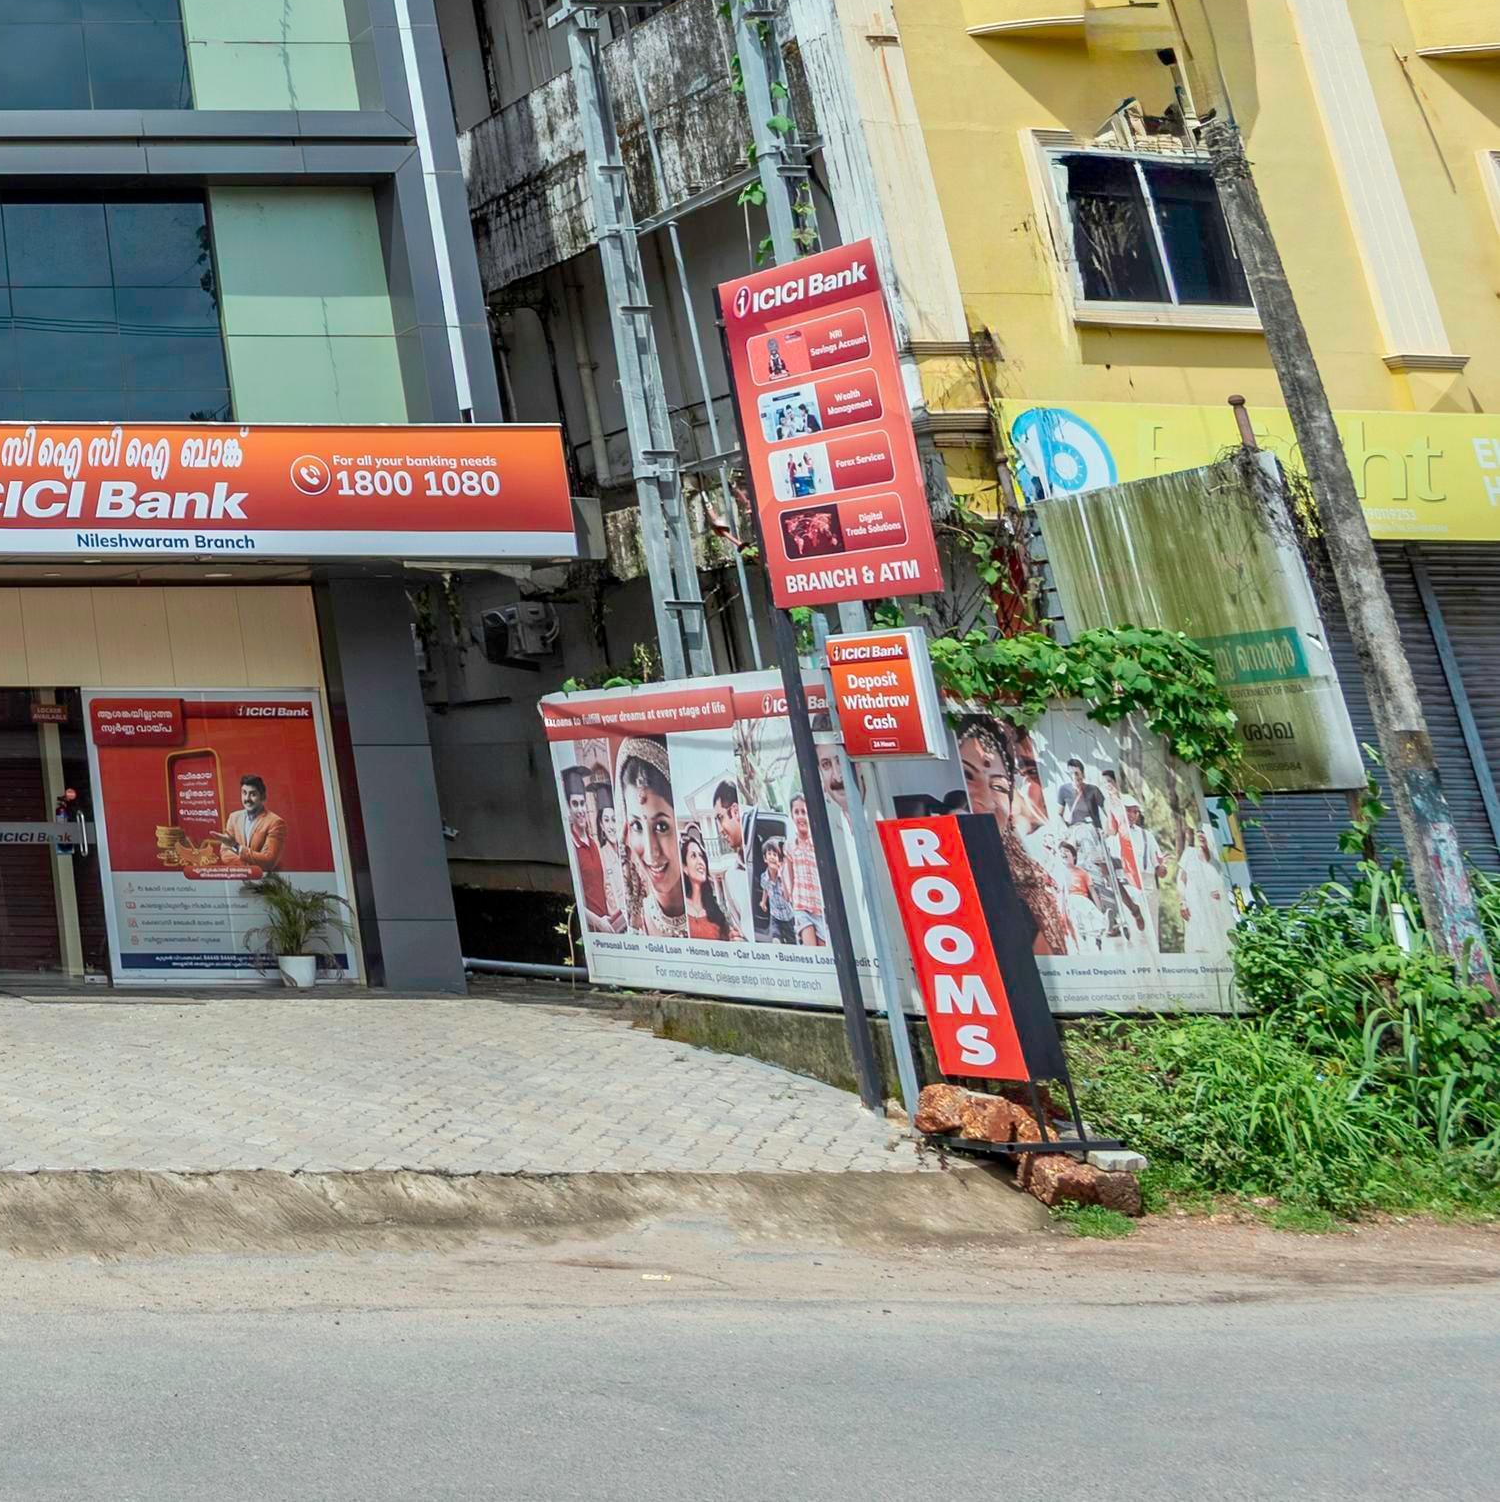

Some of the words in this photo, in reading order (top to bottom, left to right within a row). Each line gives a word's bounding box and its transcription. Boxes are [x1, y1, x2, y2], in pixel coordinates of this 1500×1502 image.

[751, 279, 805, 313] ICICI
[807, 261, 868, 298] Bank
[828, 328, 843, 340] NRI
[810, 341, 838, 357] Savings
[837, 334, 867, 350] Account
[833, 388, 861, 403] Wealth
[826, 399, 873, 416] Management
[333, 455, 353, 466] For
[356, 455, 372, 466] all
[375, 456, 404, 469] your
[405, 455, 457, 469] banking
[460, 455, 497, 467] needs
[834, 456, 855, 469] Forex
[855, 451, 886, 466] Services
[336, 470, 413, 496] 1800
[423, 470, 501, 497] 1080
[95, 481, 249, 519] Bank
[858, 510, 884, 525] Digital
[845, 525, 867, 537] Trade
[867, 521, 902, 535] Solutions
[76, 532, 190, 549] Nileshwaram
[195, 534, 256, 549] Branch
[785, 566, 858, 594] BRANCH
[861, 565, 876, 585] &
[879, 559, 920, 582] ATM
[841, 646, 871, 660] ICICI
[871, 644, 904, 658] Bank
[846, 670, 899, 691] Deposit
[842, 692, 911, 710] Withdraw
[246, 707, 276, 716] ICICI
[277, 707, 309, 717] Bank
[863, 713, 898, 731] Cash
[622, 941, 640, 951] Loan
[665, 944, 682, 955] Loan
[688, 946, 709, 958] Home
[710, 947, 729, 959] Loan
[737, 949, 750, 960] Car
[751, 951, 771, 961] Loan
[778, 952, 814, 965] Business
[898, 827, 999, 1067] ROOMS
[655, 965, 669, 978] For
[669, 969, 687, 980] more
[715, 971, 741, 986] please
[742, 973, 758, 987] step
[759, 975, 775, 988] into
[776, 978, 791, 988] our
[792, 977, 822, 991] branch
